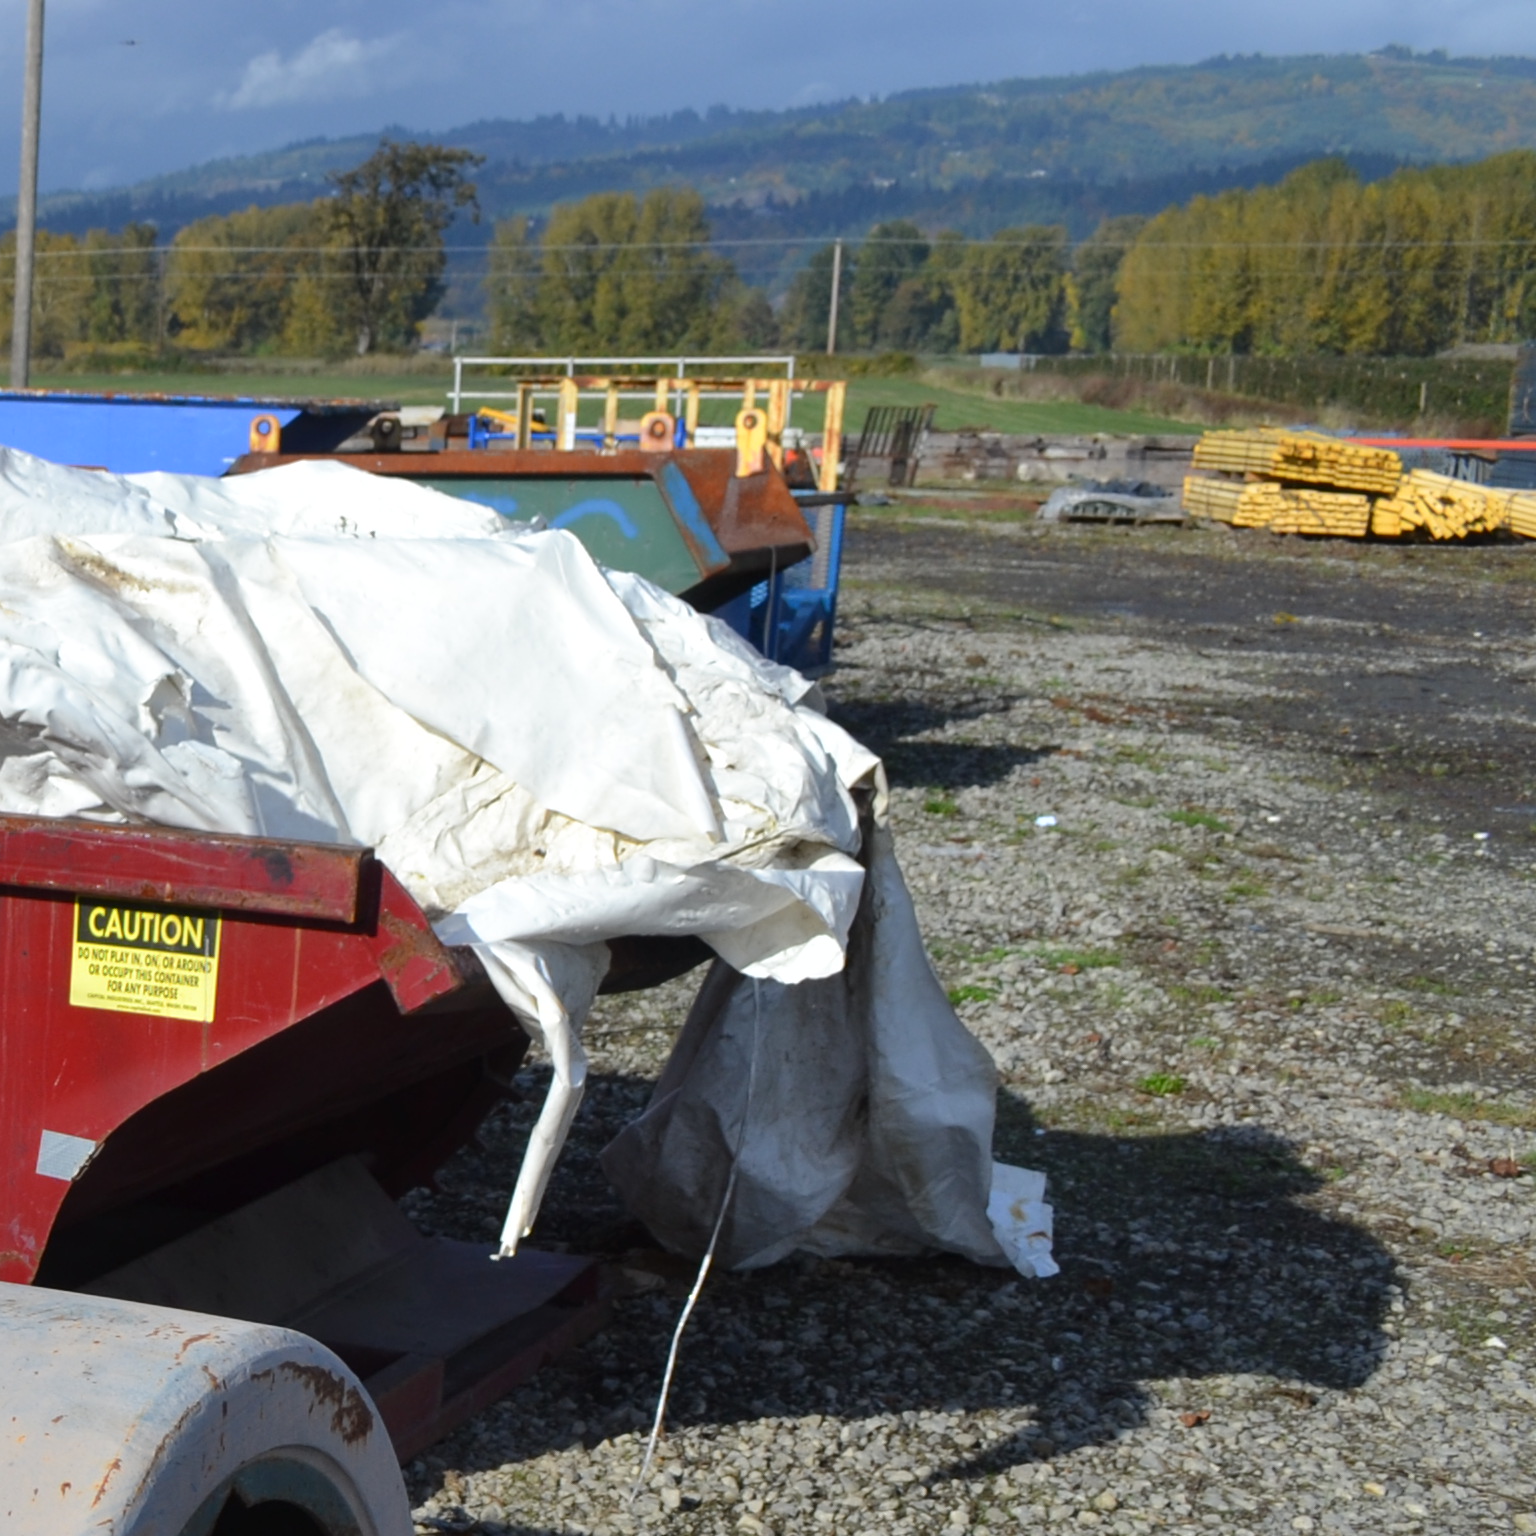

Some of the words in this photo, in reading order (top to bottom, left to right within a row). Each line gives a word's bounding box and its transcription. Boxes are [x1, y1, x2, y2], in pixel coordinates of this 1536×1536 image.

[88, 906, 204, 949] CAUTION
[78, 946, 90, 959] DO
[92, 948, 108, 961] NOT
[110, 950, 129, 963] PLAY
[162, 956, 175, 969] OR
[176, 958, 212, 974] AROUND
[88, 963, 100, 976] OR
[102, 965, 133, 980] OCCUPY
[135, 968, 152, 982] THIS
[154, 971, 199, 987] CONTAINER
[107, 980, 122, 992] FOR
[124, 982, 141, 995] ANY
[143, 985, 178, 999] PURPOSE
